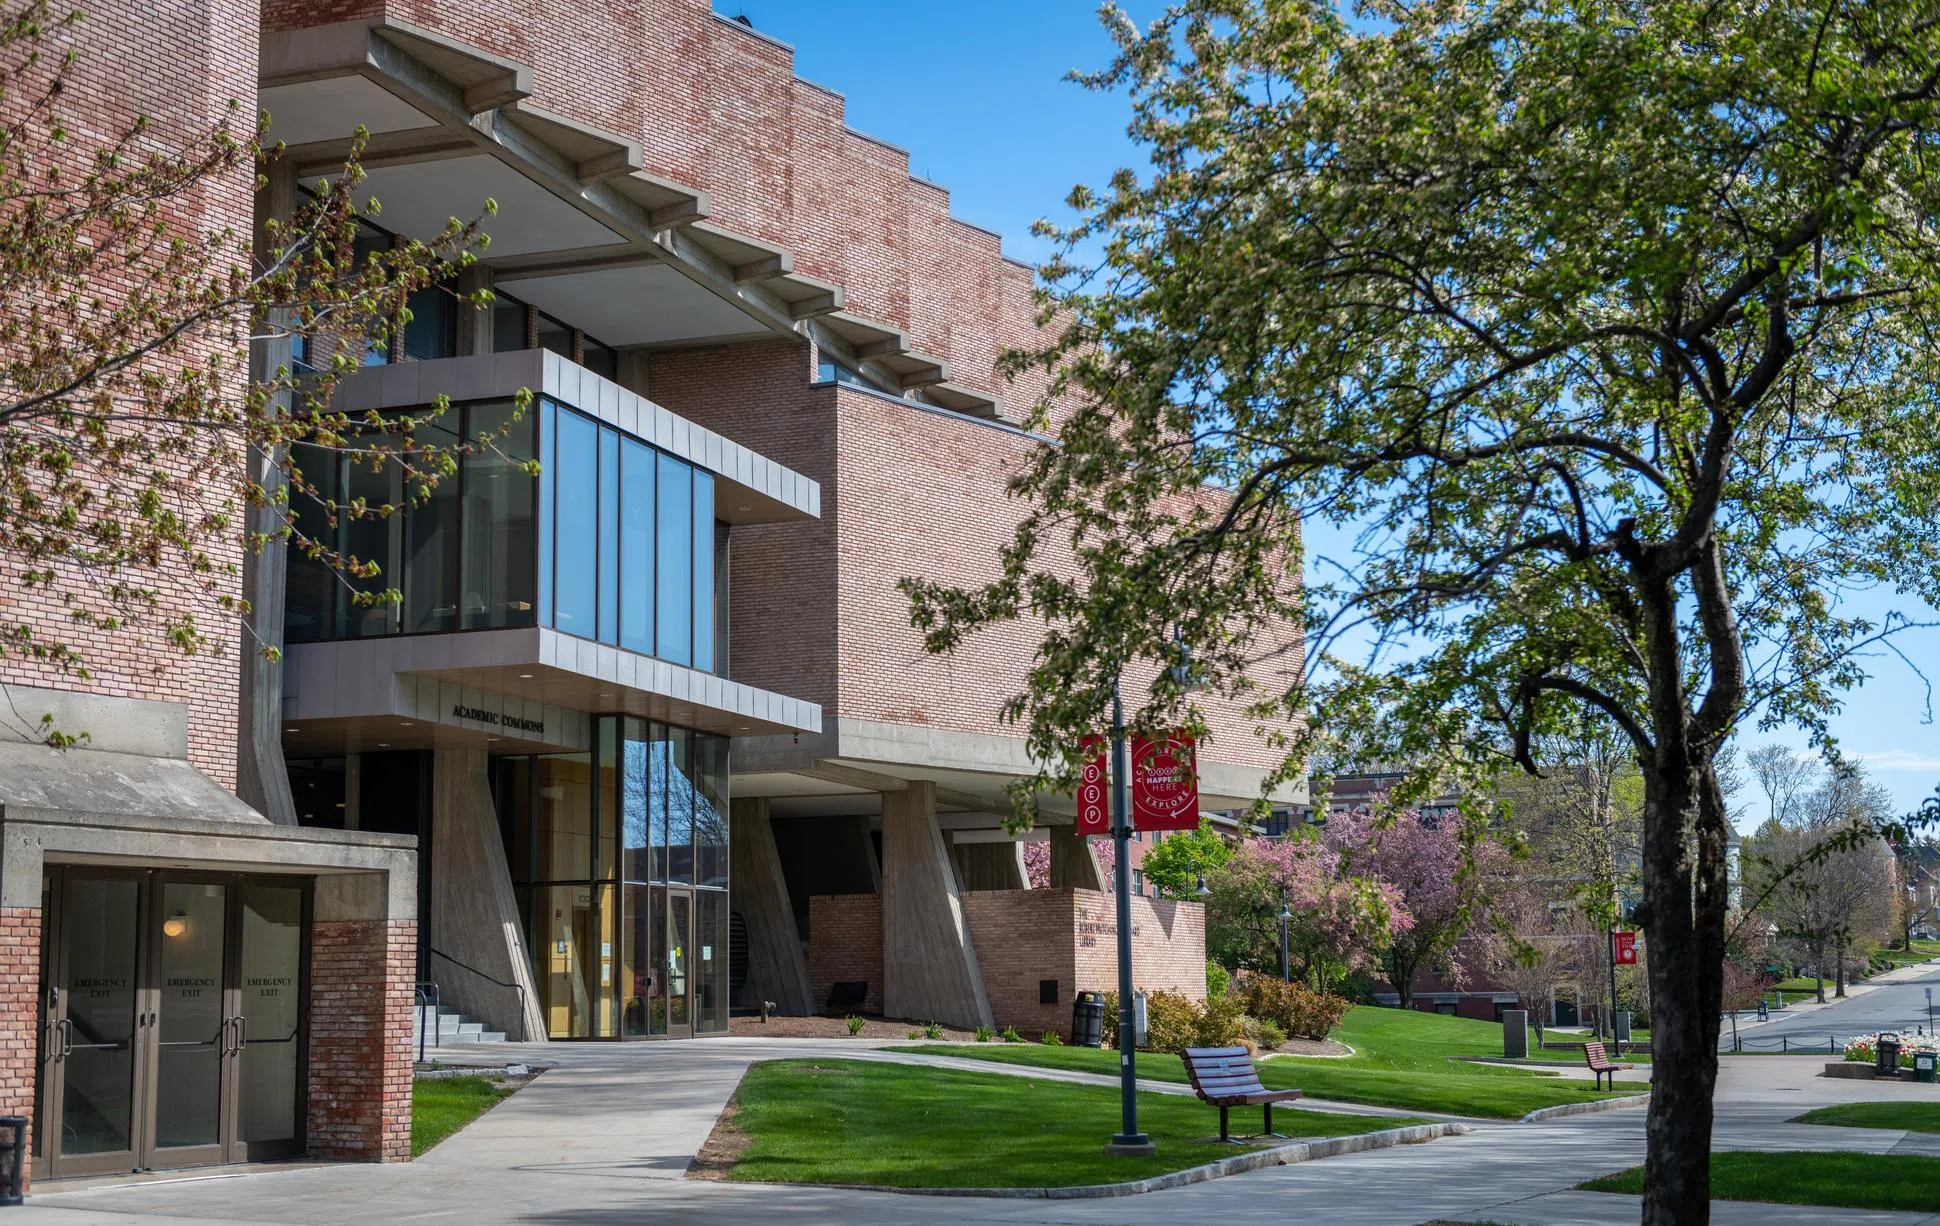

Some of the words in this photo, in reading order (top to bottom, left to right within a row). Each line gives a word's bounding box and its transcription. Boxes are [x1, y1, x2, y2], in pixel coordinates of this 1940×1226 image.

[453, 705, 499, 725] ACADEMIC
[502, 714, 545, 733] COMMONS
[1148, 767, 1178, 776] LEE
[1152, 783, 1177, 791] HERE
[1145, 790, 1189, 808] EXPLORE
[74, 977, 127, 988] EMERGENCY
[167, 977, 216, 987] EMERGENCY
[247, 978, 292, 986] EMERGENCY
[90, 990, 111, 998] EXIT
[182, 989, 201, 998] EXIT
[261, 988, 280, 997] EXIT
